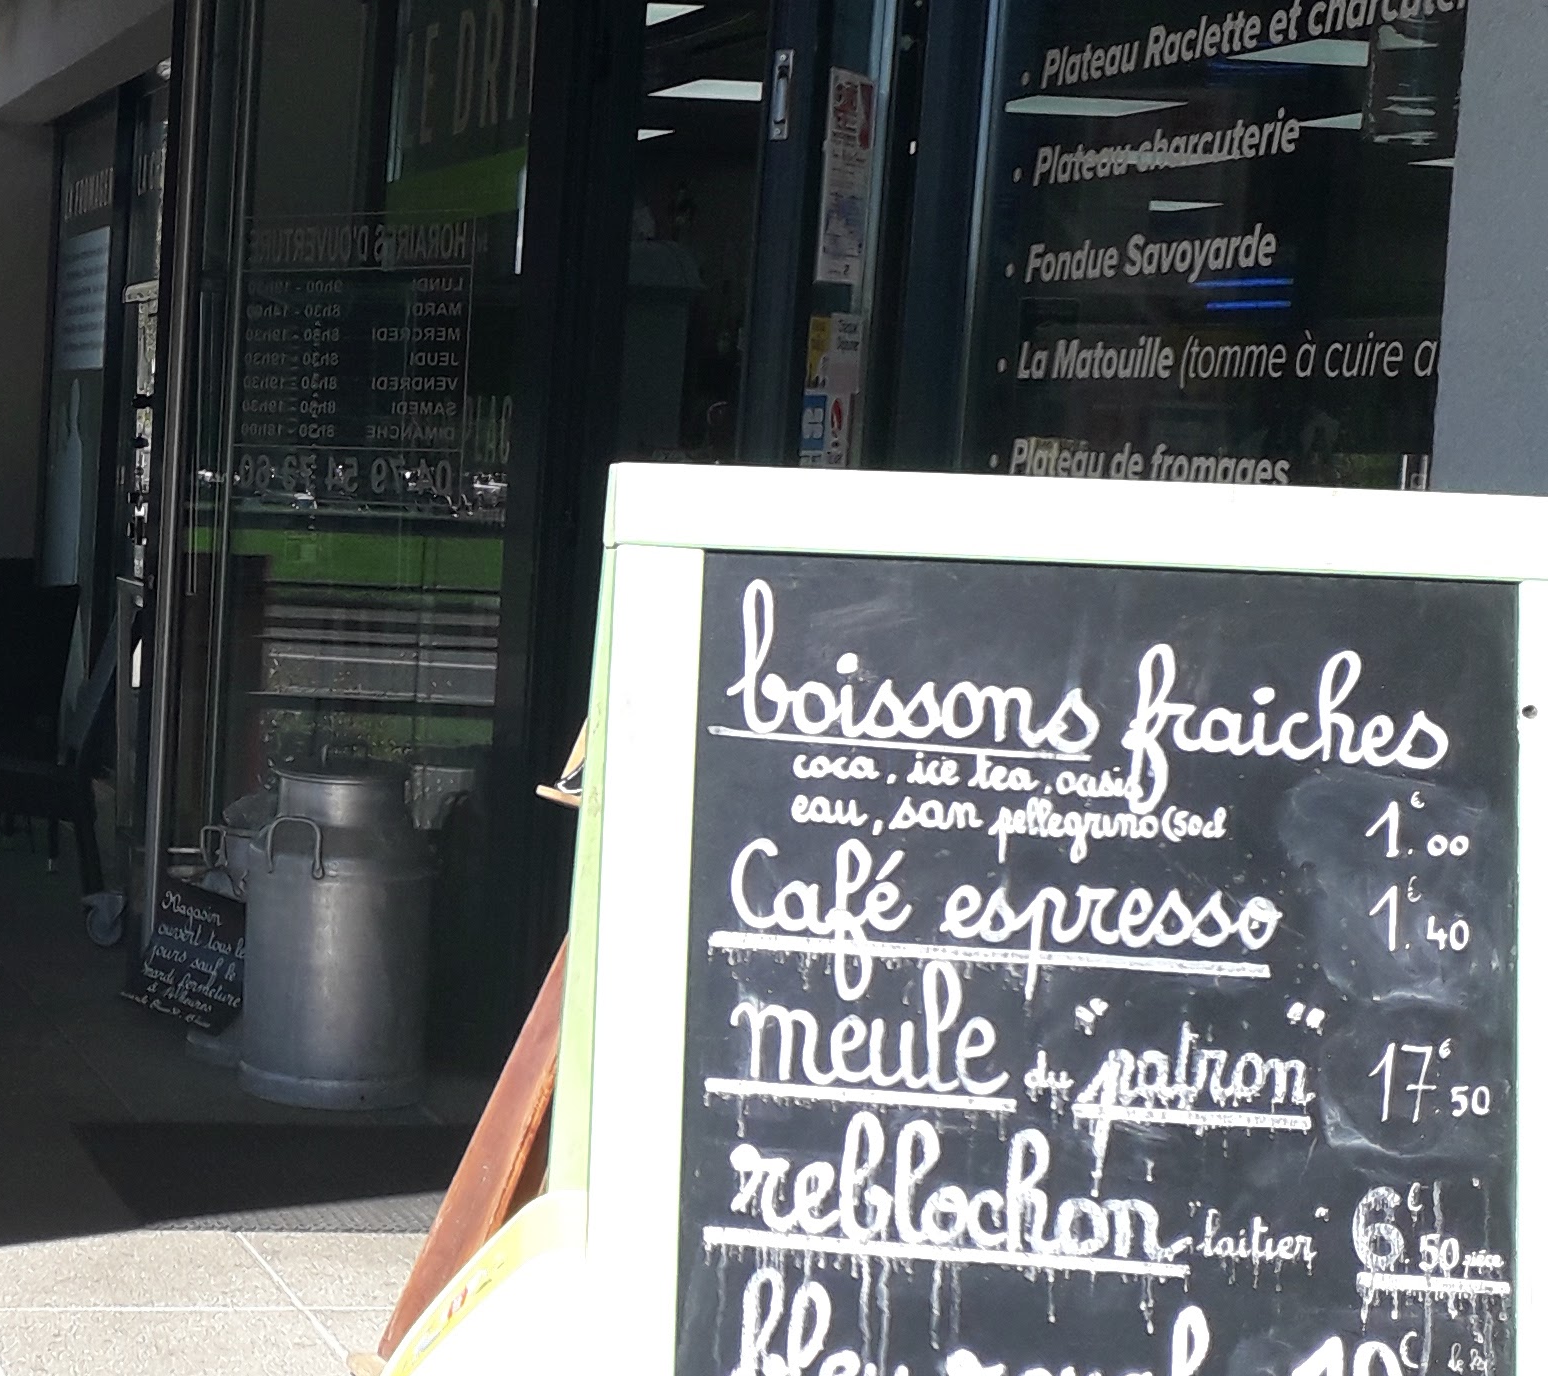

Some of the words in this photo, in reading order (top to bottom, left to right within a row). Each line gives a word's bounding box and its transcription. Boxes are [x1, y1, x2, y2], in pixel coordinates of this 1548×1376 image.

[1040, 40, 1148, 89] Plateau
[1144, 11, 1261, 70] Raclette
[1033, 142, 1132, 187] Plateau
[1137, 107, 1301, 176] charcuterie
[1024, 242, 1119, 284] Fondue
[1123, 222, 1278, 283] Savoyarde
[1017, 341, 1049, 380] La
[1051, 335, 1173, 381] Matouille
[1178, 335, 1288, 389] (tomme
[1295, 328, 1315, 378] à
[1324, 330, 1404, 378] cuire
[1010, 435, 1106, 478] Plateau
[1112, 442, 1143, 480] de
[727, 580, 1099, 753] boissons
[1124, 643, 1449, 811] fraiches
[906, 752, 960, 785] ice
[889, 796, 985, 833] san
[158, 923, 202, 946] ouvert
[205, 930, 232, 955] tous
[161, 890, 222, 933] Magasin
[730, 837, 913, 1000] Café
[940, 881, 1282, 1000] espresso
[149, 944, 187, 965] jours
[190, 957, 224, 985] sauf
[730, 961, 1016, 1094] meule
[1024, 1050, 1074, 1090] du
[729, 1112, 1194, 1264] reblochon
